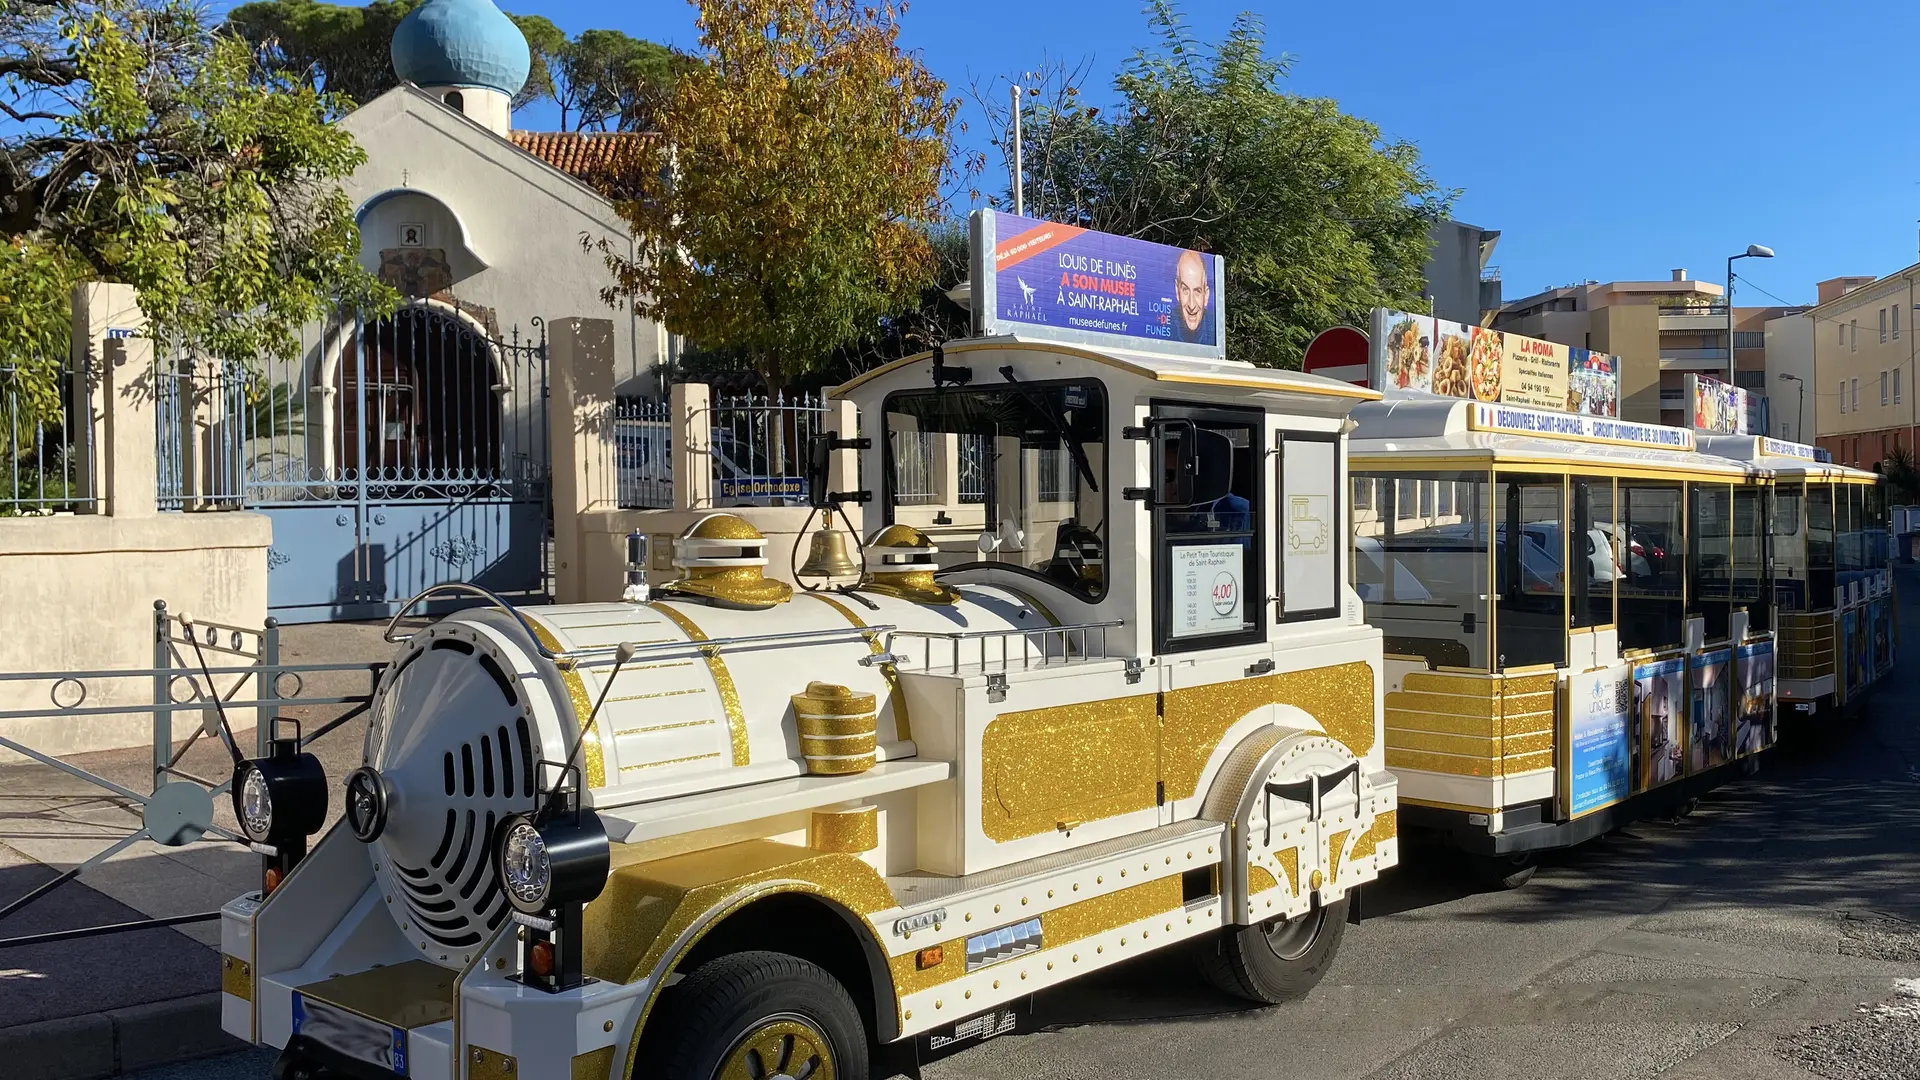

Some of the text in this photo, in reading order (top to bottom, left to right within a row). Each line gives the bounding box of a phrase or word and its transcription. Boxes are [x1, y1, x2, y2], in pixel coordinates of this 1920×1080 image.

[1059, 253, 1136, 279] LOUIS DE FUNÈS
[1061, 272, 1135, 296] A SON MUSÉE
[1013, 304, 1042, 312] SAINT
[1057, 286, 1139, 316] À SAINT-RAPHAËL
[1149, 302, 1171, 314] LOUIS
[1069, 316, 1128, 332] museedefunes.fr
[1521, 340, 1554, 357] LA ROMA
[1513, 352, 1527, 362] Pizzeria
[1542, 358, 1560, 368] Ristorante
[1498, 407, 1535, 430] DÉCOUVREZ
[1537, 414, 1584, 435] SAINT-RAPHAËL
[1593, 421, 1614, 438] CIRCUIT
[1645, 428, 1651, 442] DE
[1652, 429, 1658, 443] 30
[1659, 430, 1680, 445] MINUTES
[724, 482, 800, 495] Egise Orthodoxe
[1210, 550, 1234, 558] Touristique
[394, 1052, 404, 1068] 83
